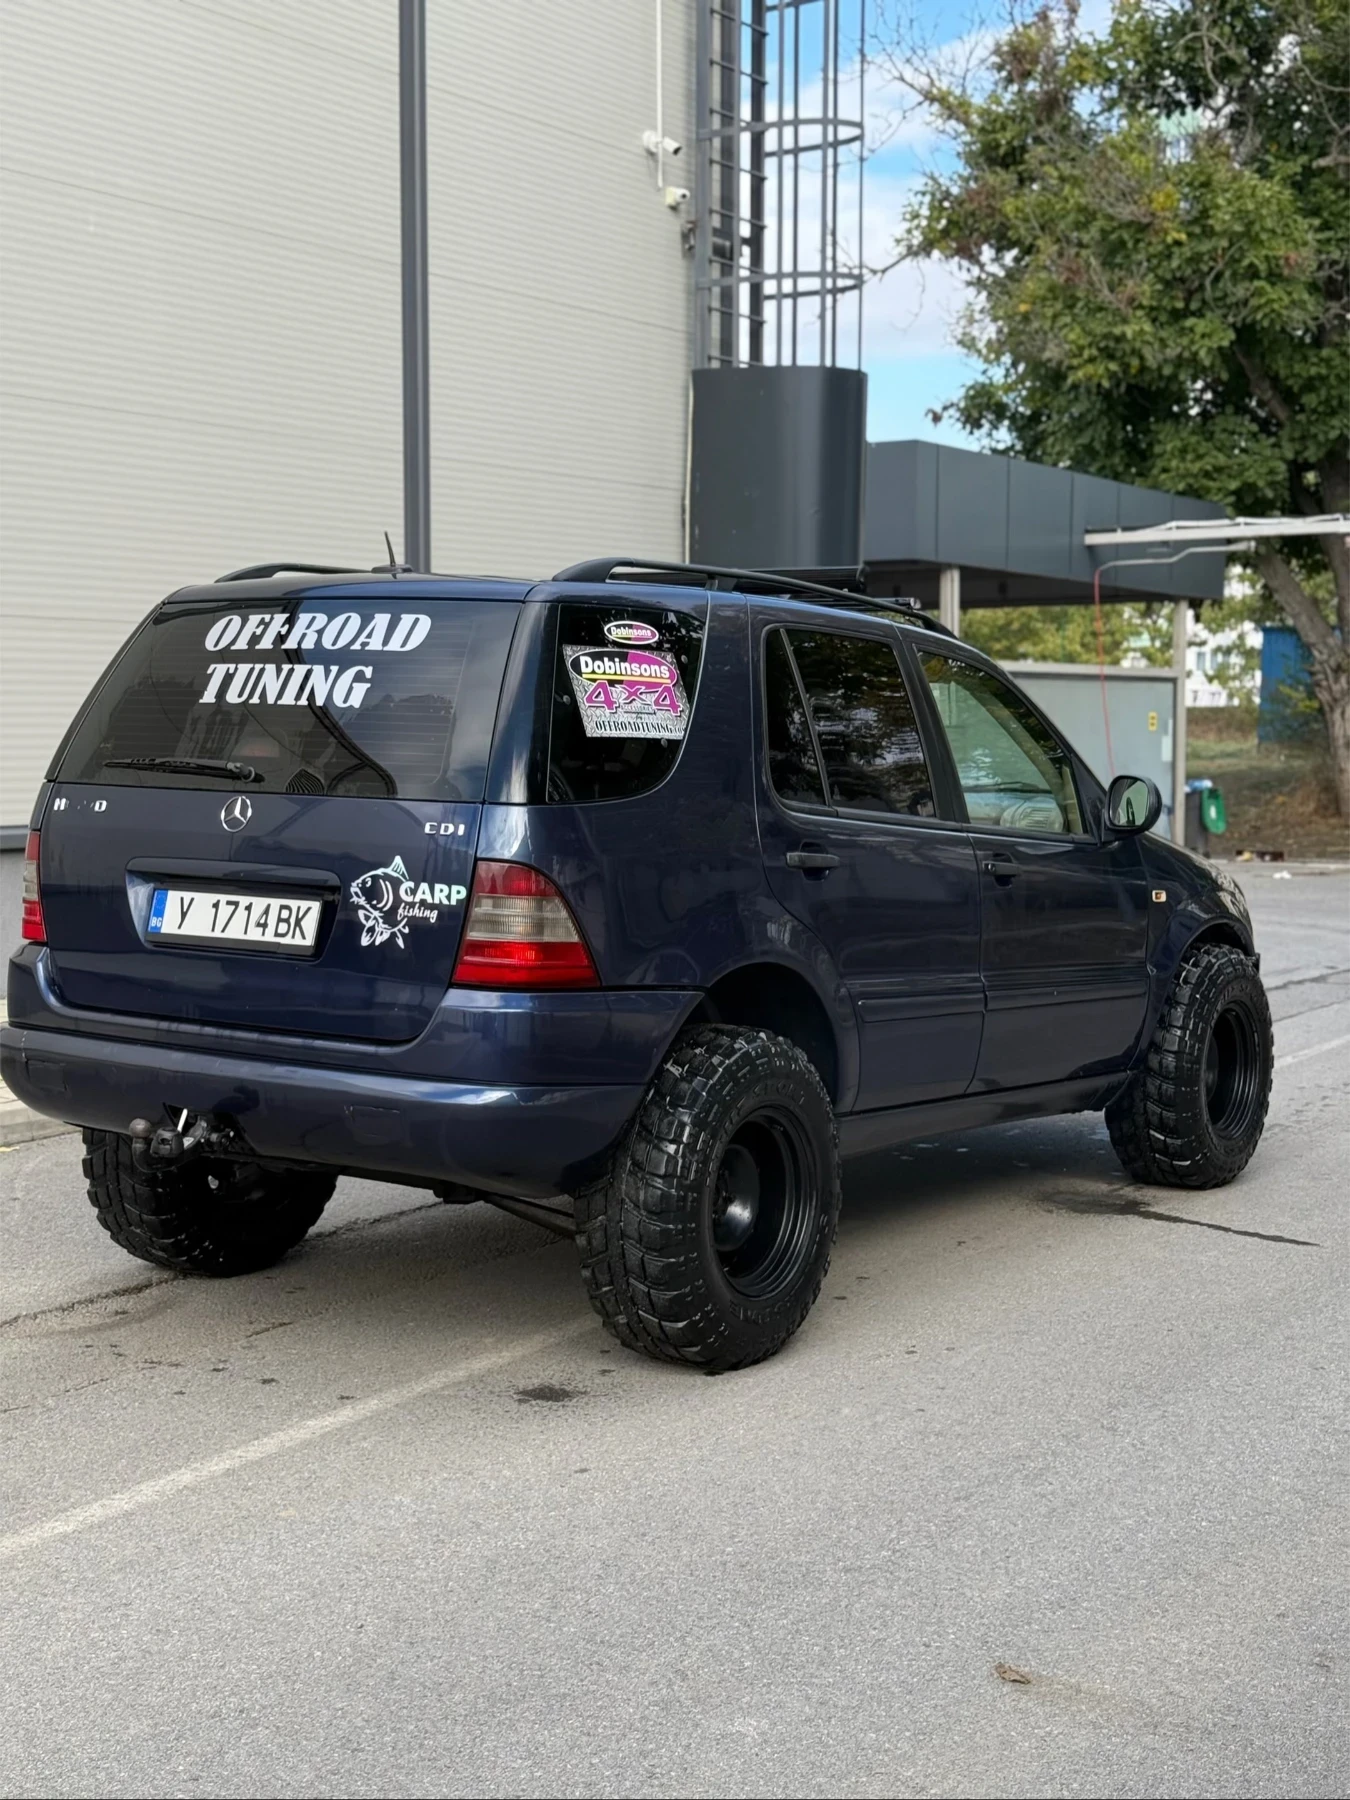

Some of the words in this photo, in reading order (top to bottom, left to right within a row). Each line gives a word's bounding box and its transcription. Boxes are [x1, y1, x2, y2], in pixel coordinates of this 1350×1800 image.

[204, 612, 431, 652] OFFROAD
[610, 626, 652, 637] Dobinsons
[580, 656, 669, 678] Dobinsons
[199, 663, 373, 708] TUNING
[424, 821, 465, 836] CDI
[399, 881, 467, 905] CARP
[151, 916, 163, 927] BG
[397, 902, 438, 923] fishing
